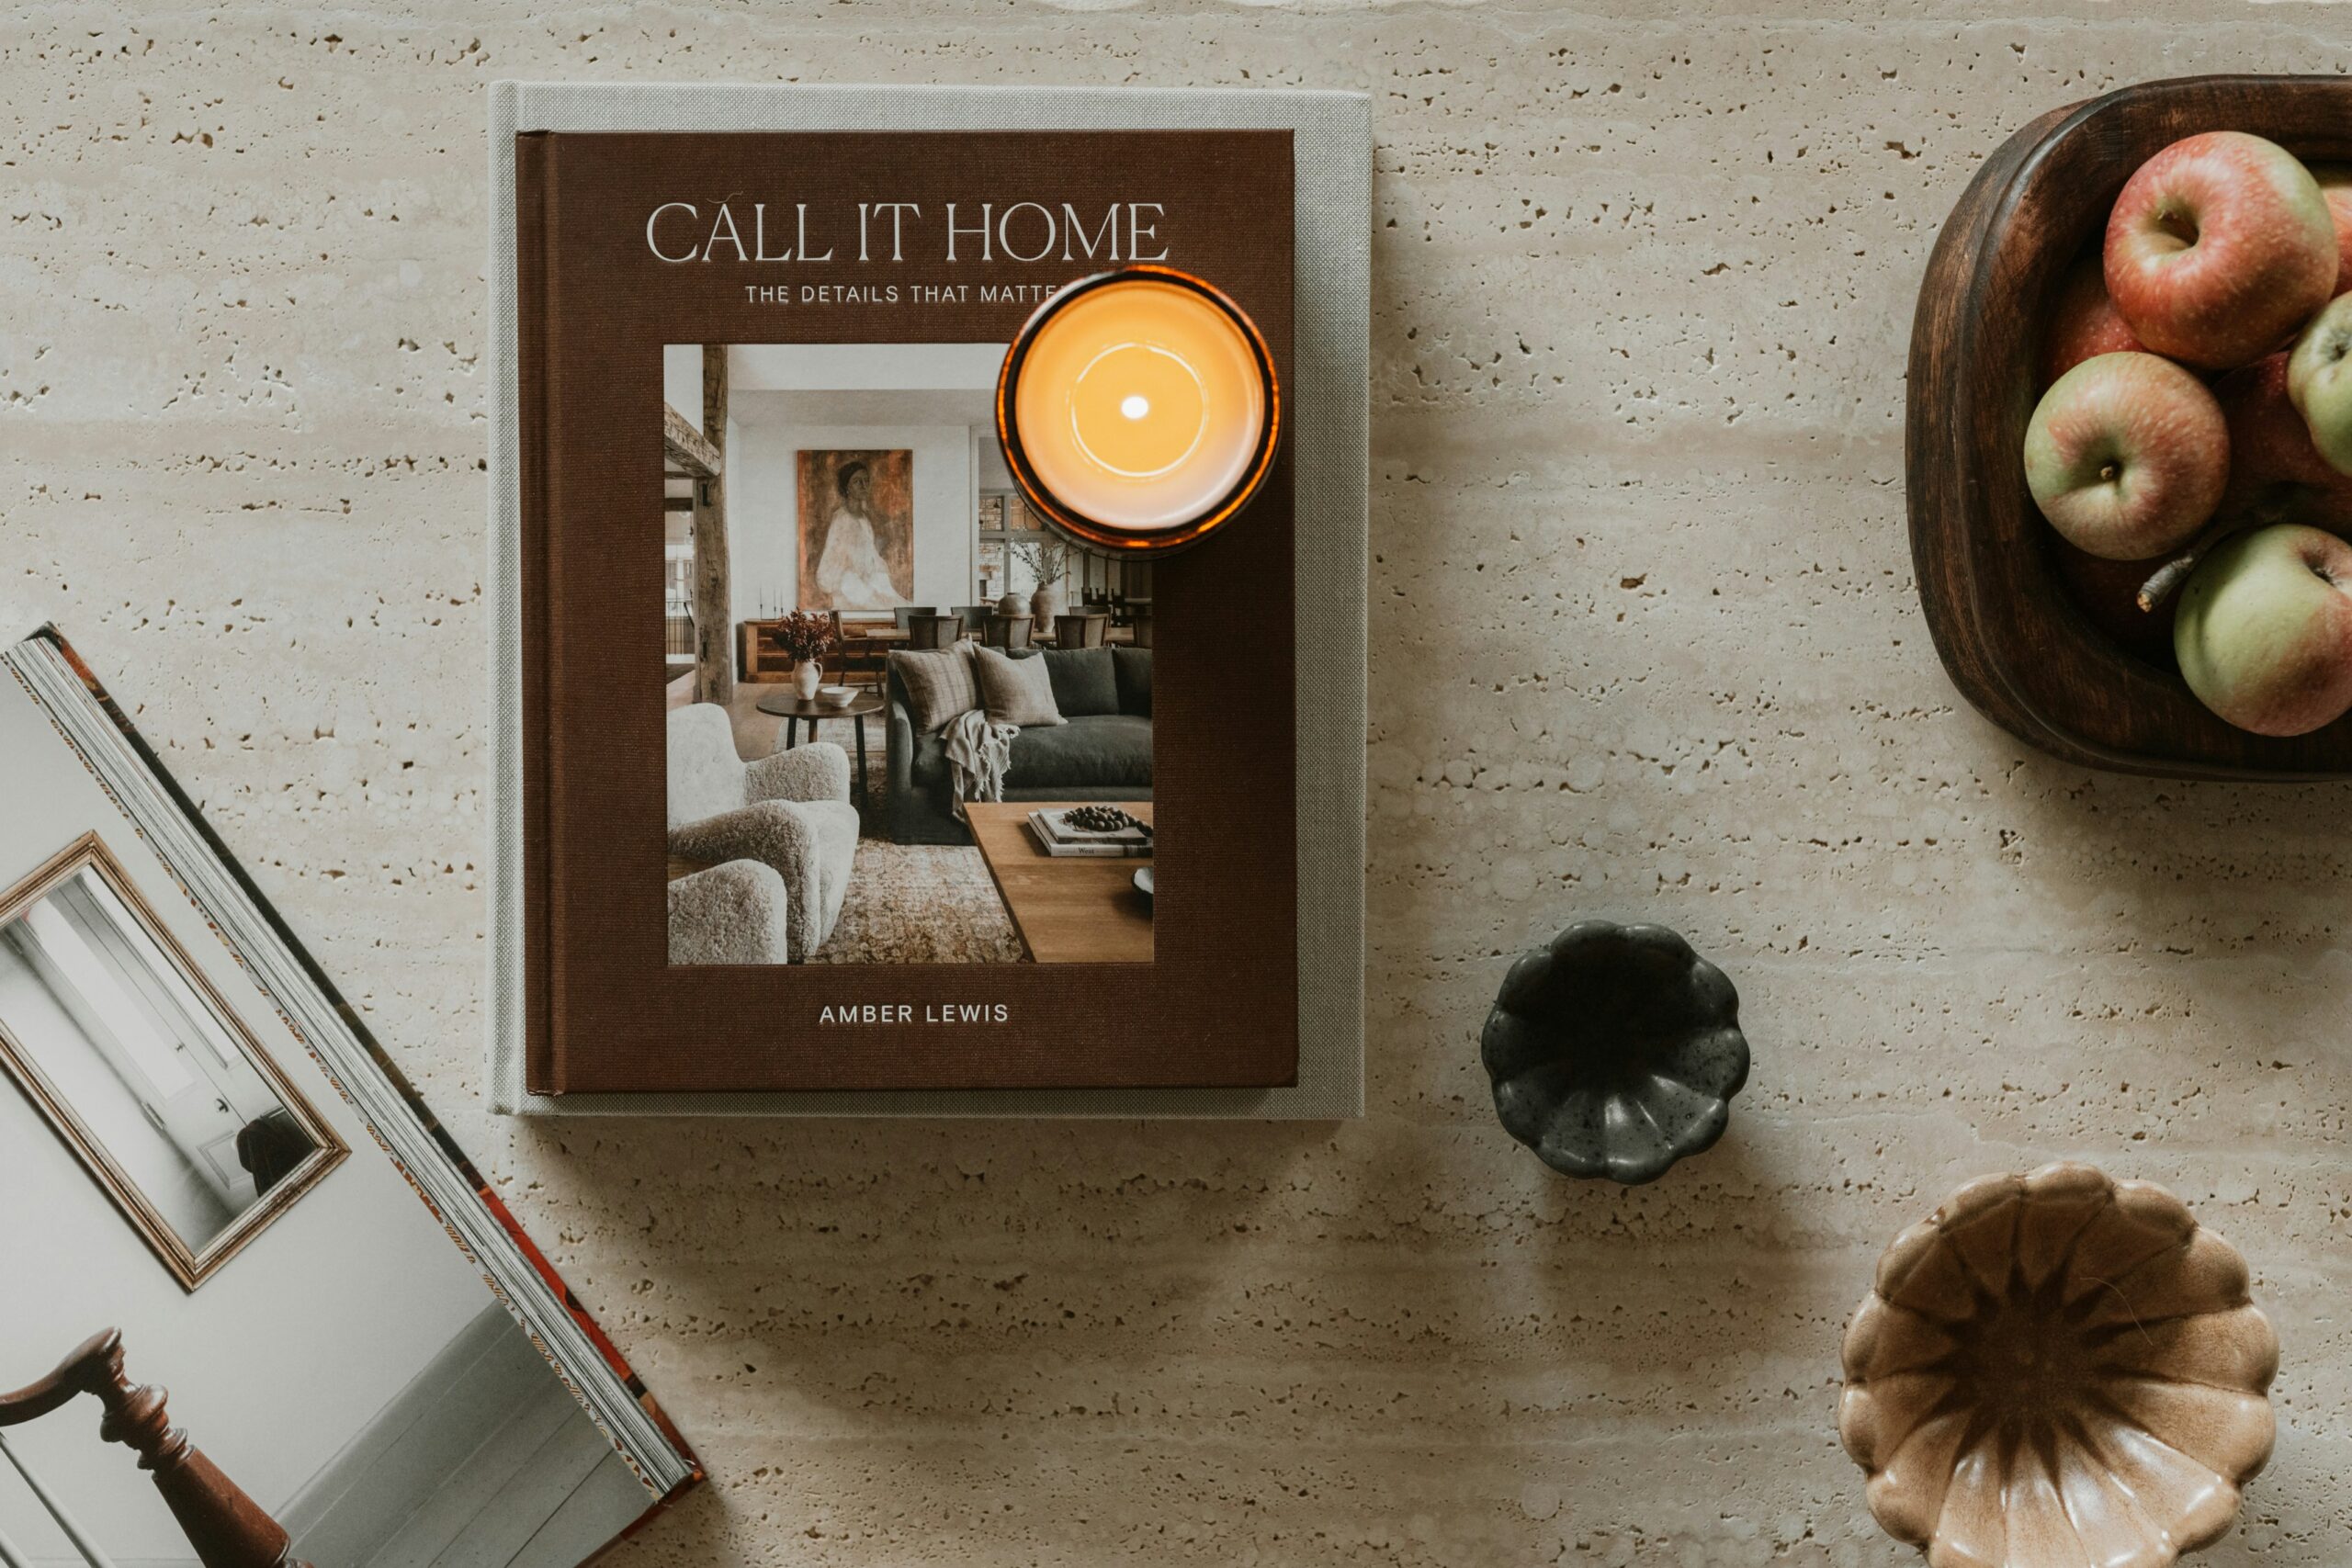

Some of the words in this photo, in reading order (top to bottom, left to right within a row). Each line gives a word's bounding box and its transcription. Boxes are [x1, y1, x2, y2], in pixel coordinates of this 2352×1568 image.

[646, 202, 833, 263] CALL
[858, 203, 921, 262] IT
[945, 202, 1169, 262] HOME
[745, 286, 789, 303] THE
[801, 285, 899, 303] DETAILS
[910, 285, 968, 303] THAT
[980, 285, 1065, 302] MATTE
[819, 1005, 912, 1023] AMBER
[926, 1004, 1008, 1022] LEWIS
